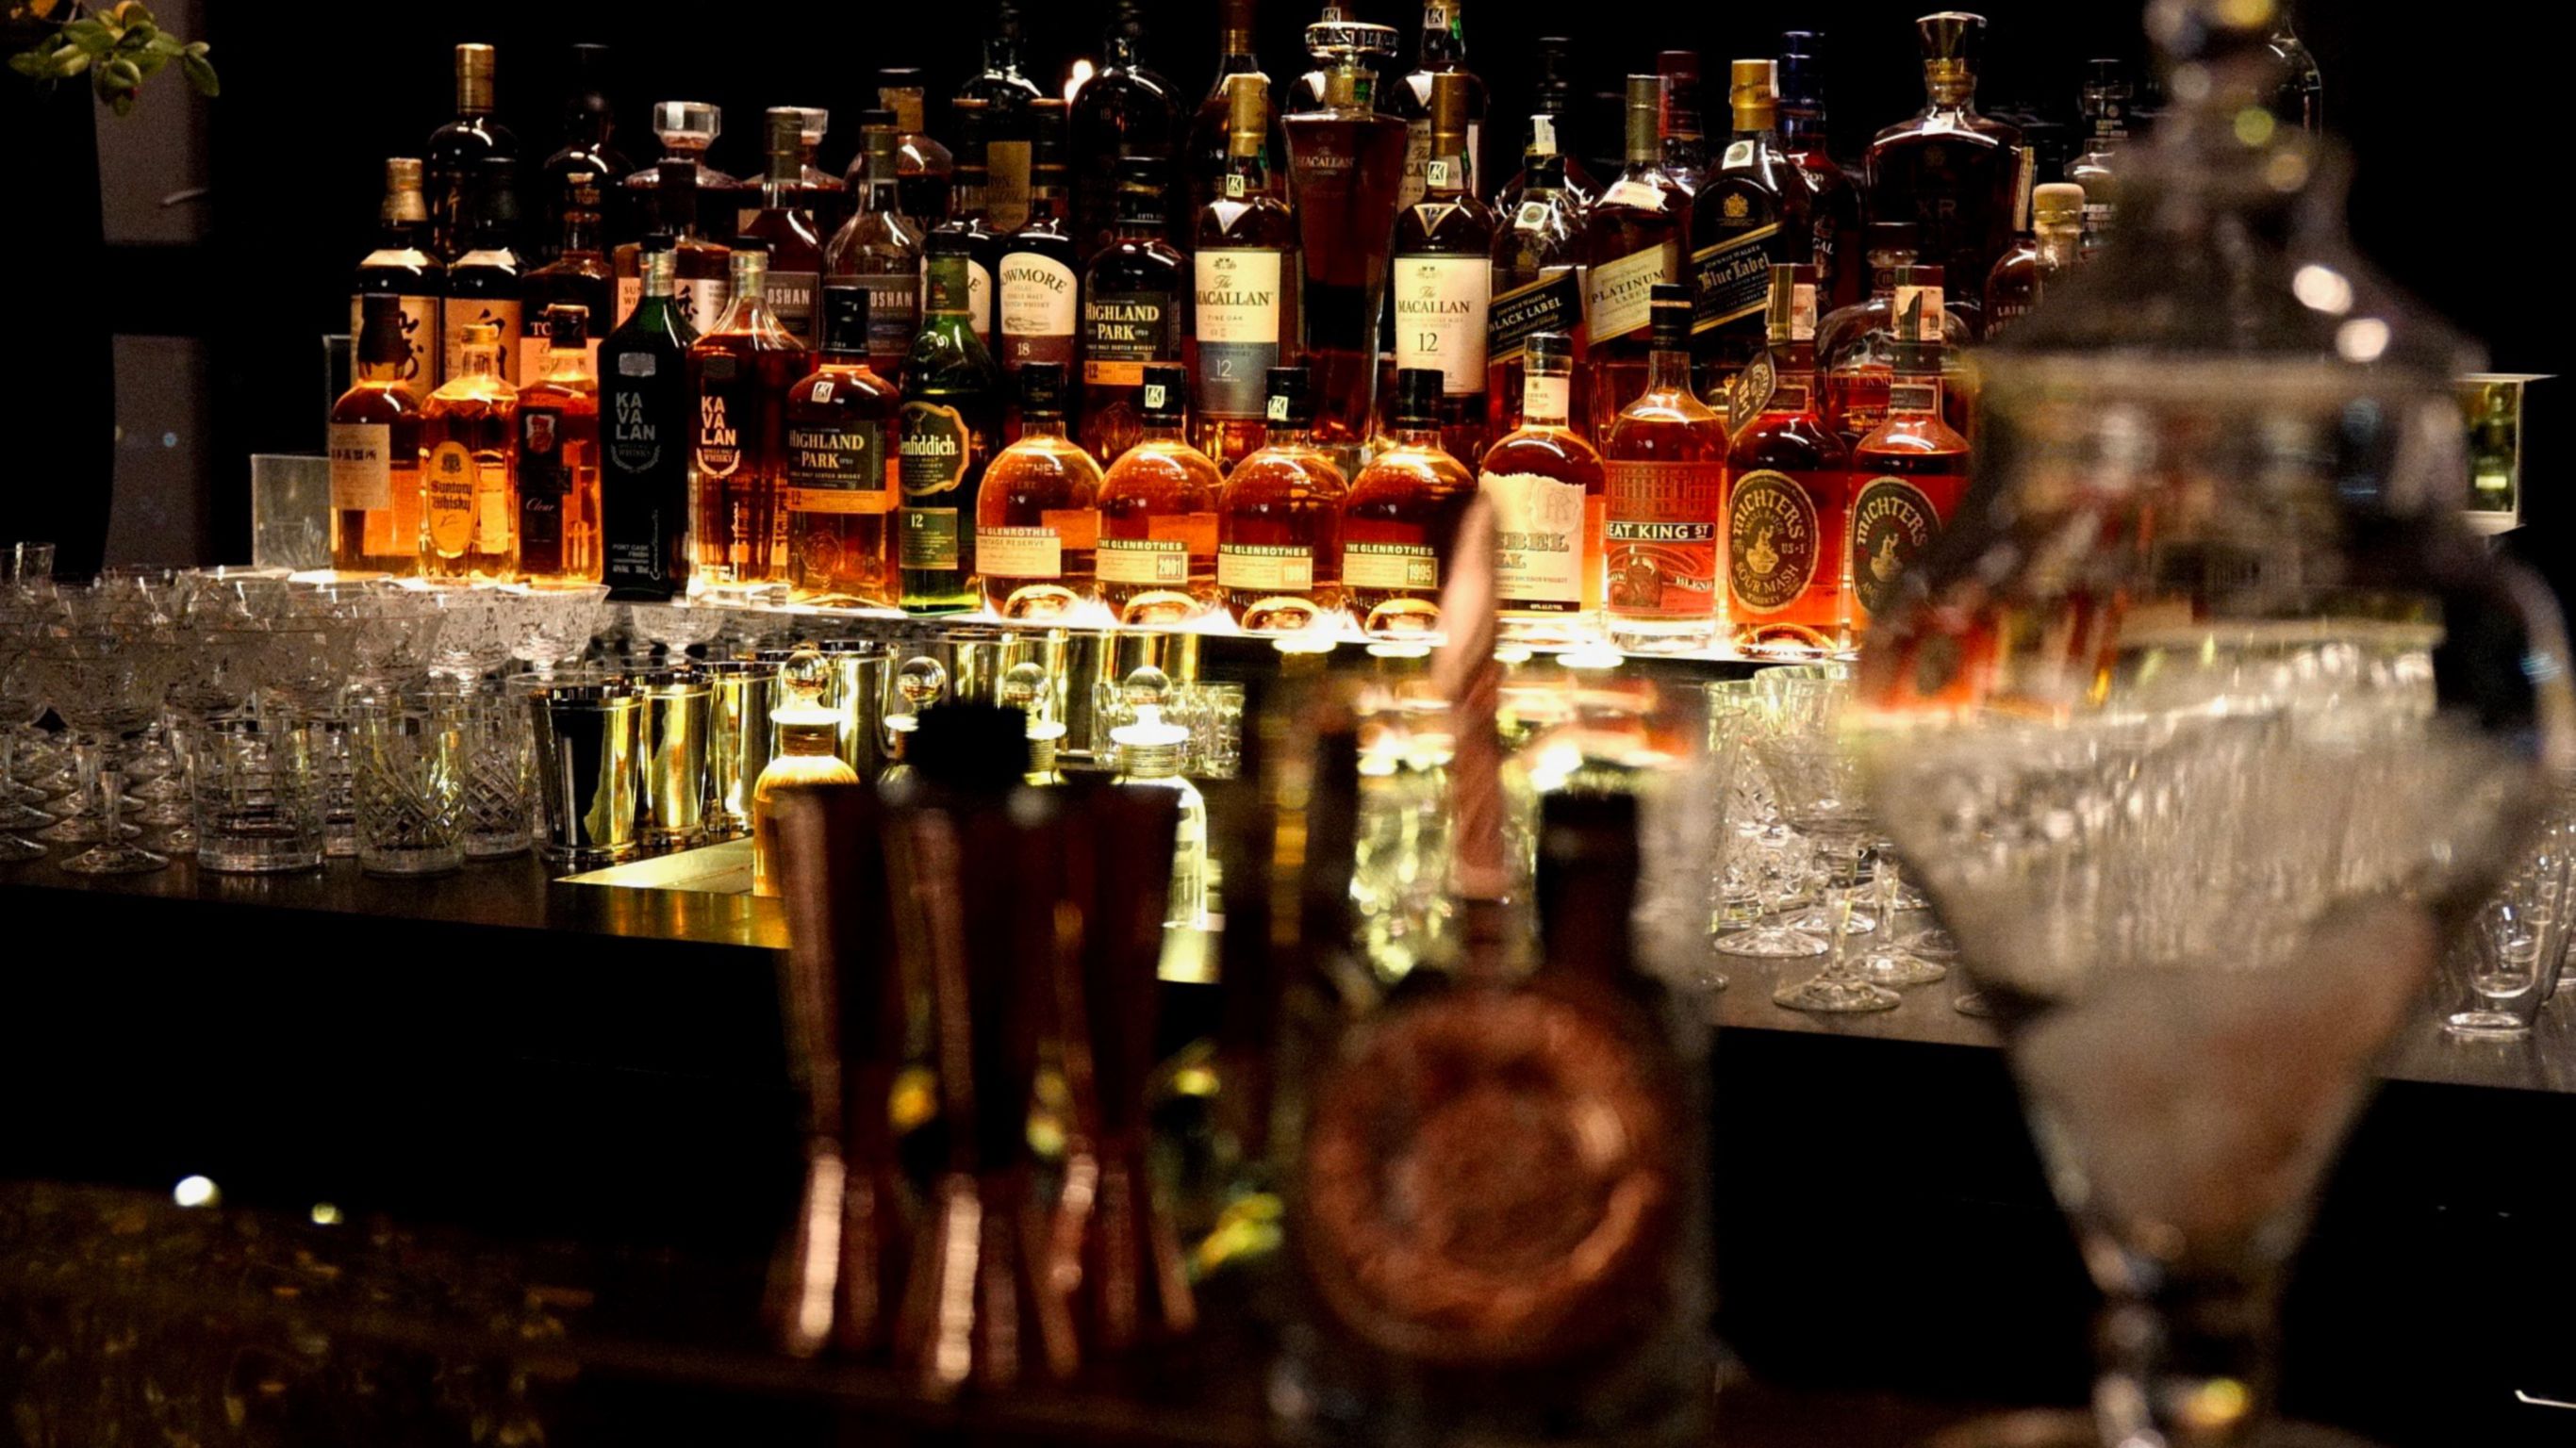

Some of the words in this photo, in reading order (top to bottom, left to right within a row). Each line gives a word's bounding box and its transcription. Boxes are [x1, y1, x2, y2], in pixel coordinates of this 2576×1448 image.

[1001, 269, 1067, 294] OWMORE
[1592, 270, 1666, 304] PLATINUM
[768, 288, 811, 304] OSHAN
[870, 290, 914, 307] OSHAN
[1085, 303, 1160, 321] HIGHLAND
[1397, 301, 1472, 314] MACALLAN
[1527, 297, 1563, 318] LABEL
[1098, 322, 1136, 340] PARK
[1017, 343, 1031, 355] 18
[1419, 332, 1439, 352] 12
[1216, 359, 1232, 377] 12
[789, 429, 866, 451] HIGHLAND
[801, 451, 840, 469] PARK
[431, 480, 473, 496] Suntory
[432, 496, 471, 513] Whisky
[911, 514, 923, 528] 12
[987, 528, 1055, 536] GLENROTHES
[1639, 525, 1689, 538] KING
[1694, 525, 1709, 537] ST
[1111, 540, 1182, 551] GLENROTHES
[1220, 544, 1232, 552] THE
[1234, 545, 1308, 556] GLENROTHES
[1361, 544, 1433, 555] GLENROTHES
[1159, 559, 1181, 575] 2001
[1410, 564, 1432, 581] 1995
[1763, 564, 1799, 595] MASH
